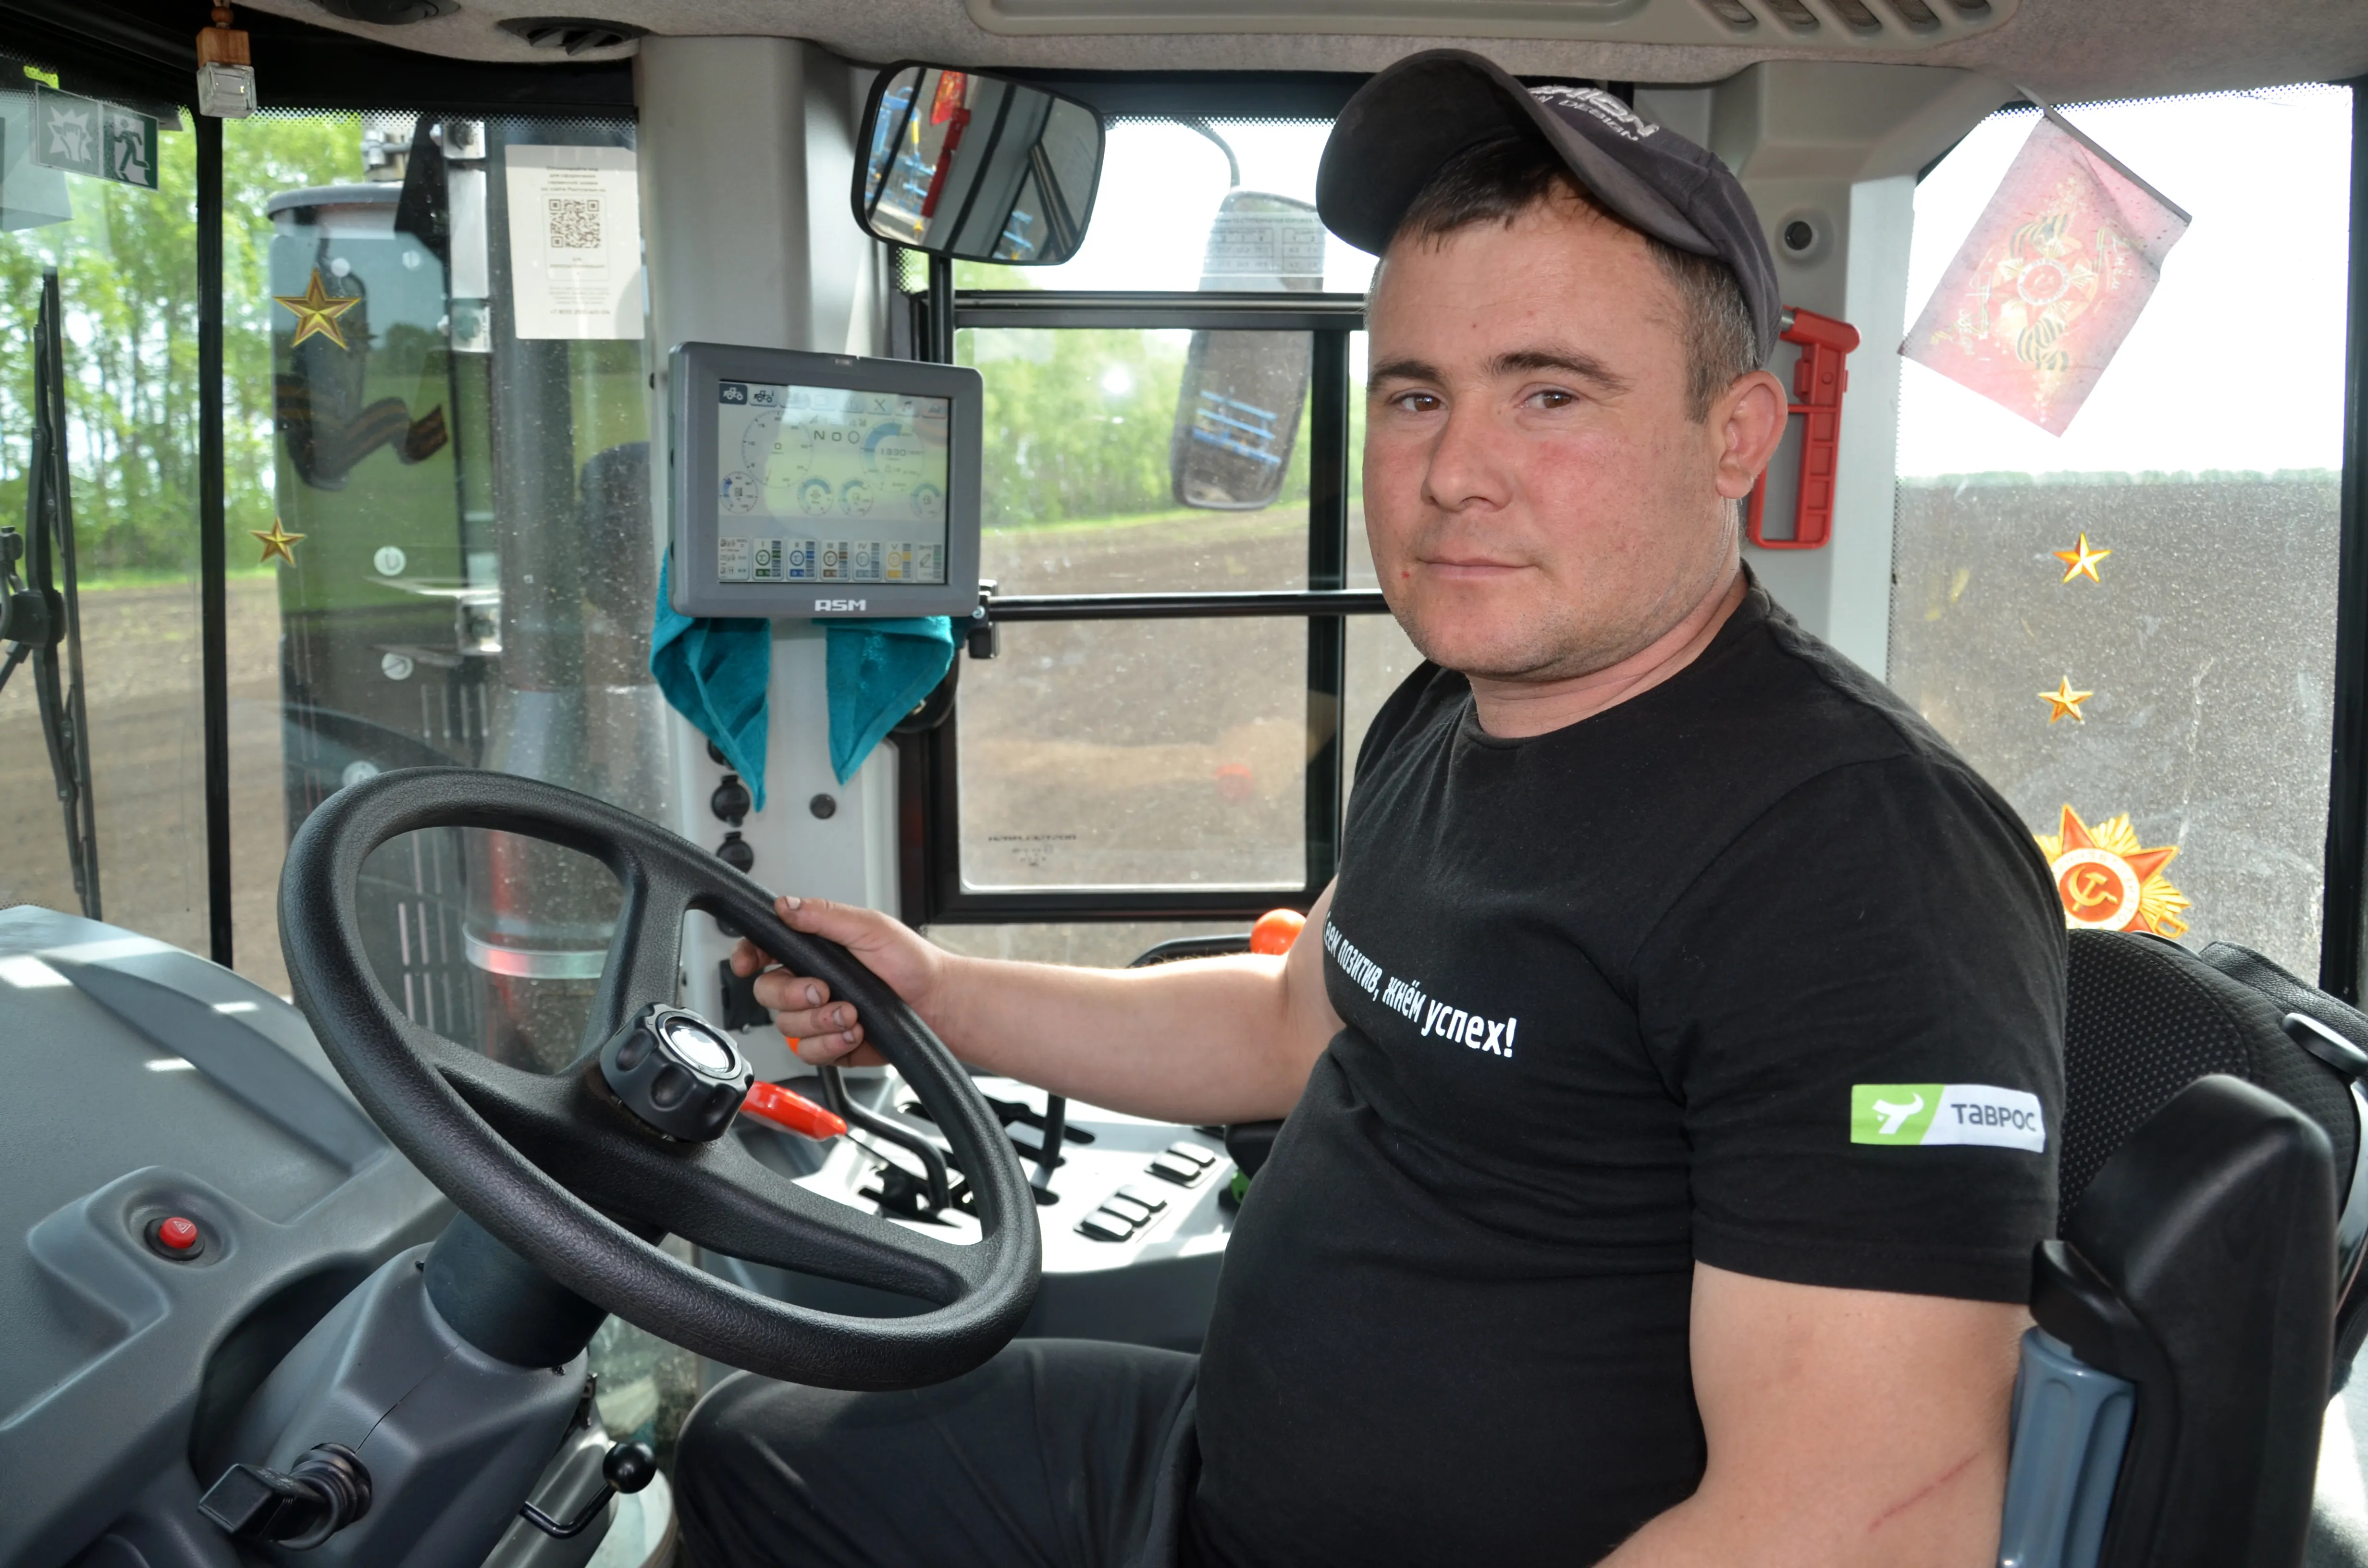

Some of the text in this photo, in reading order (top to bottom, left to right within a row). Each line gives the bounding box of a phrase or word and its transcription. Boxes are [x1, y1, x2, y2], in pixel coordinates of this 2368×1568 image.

[1558, 99, 1639, 141] DESIGN
[814, 430, 826, 441] N
[1337, 939, 1383, 1002] позитив,
[1382, 977, 1427, 1023] жнём
[1421, 999, 1517, 1058] успех!
